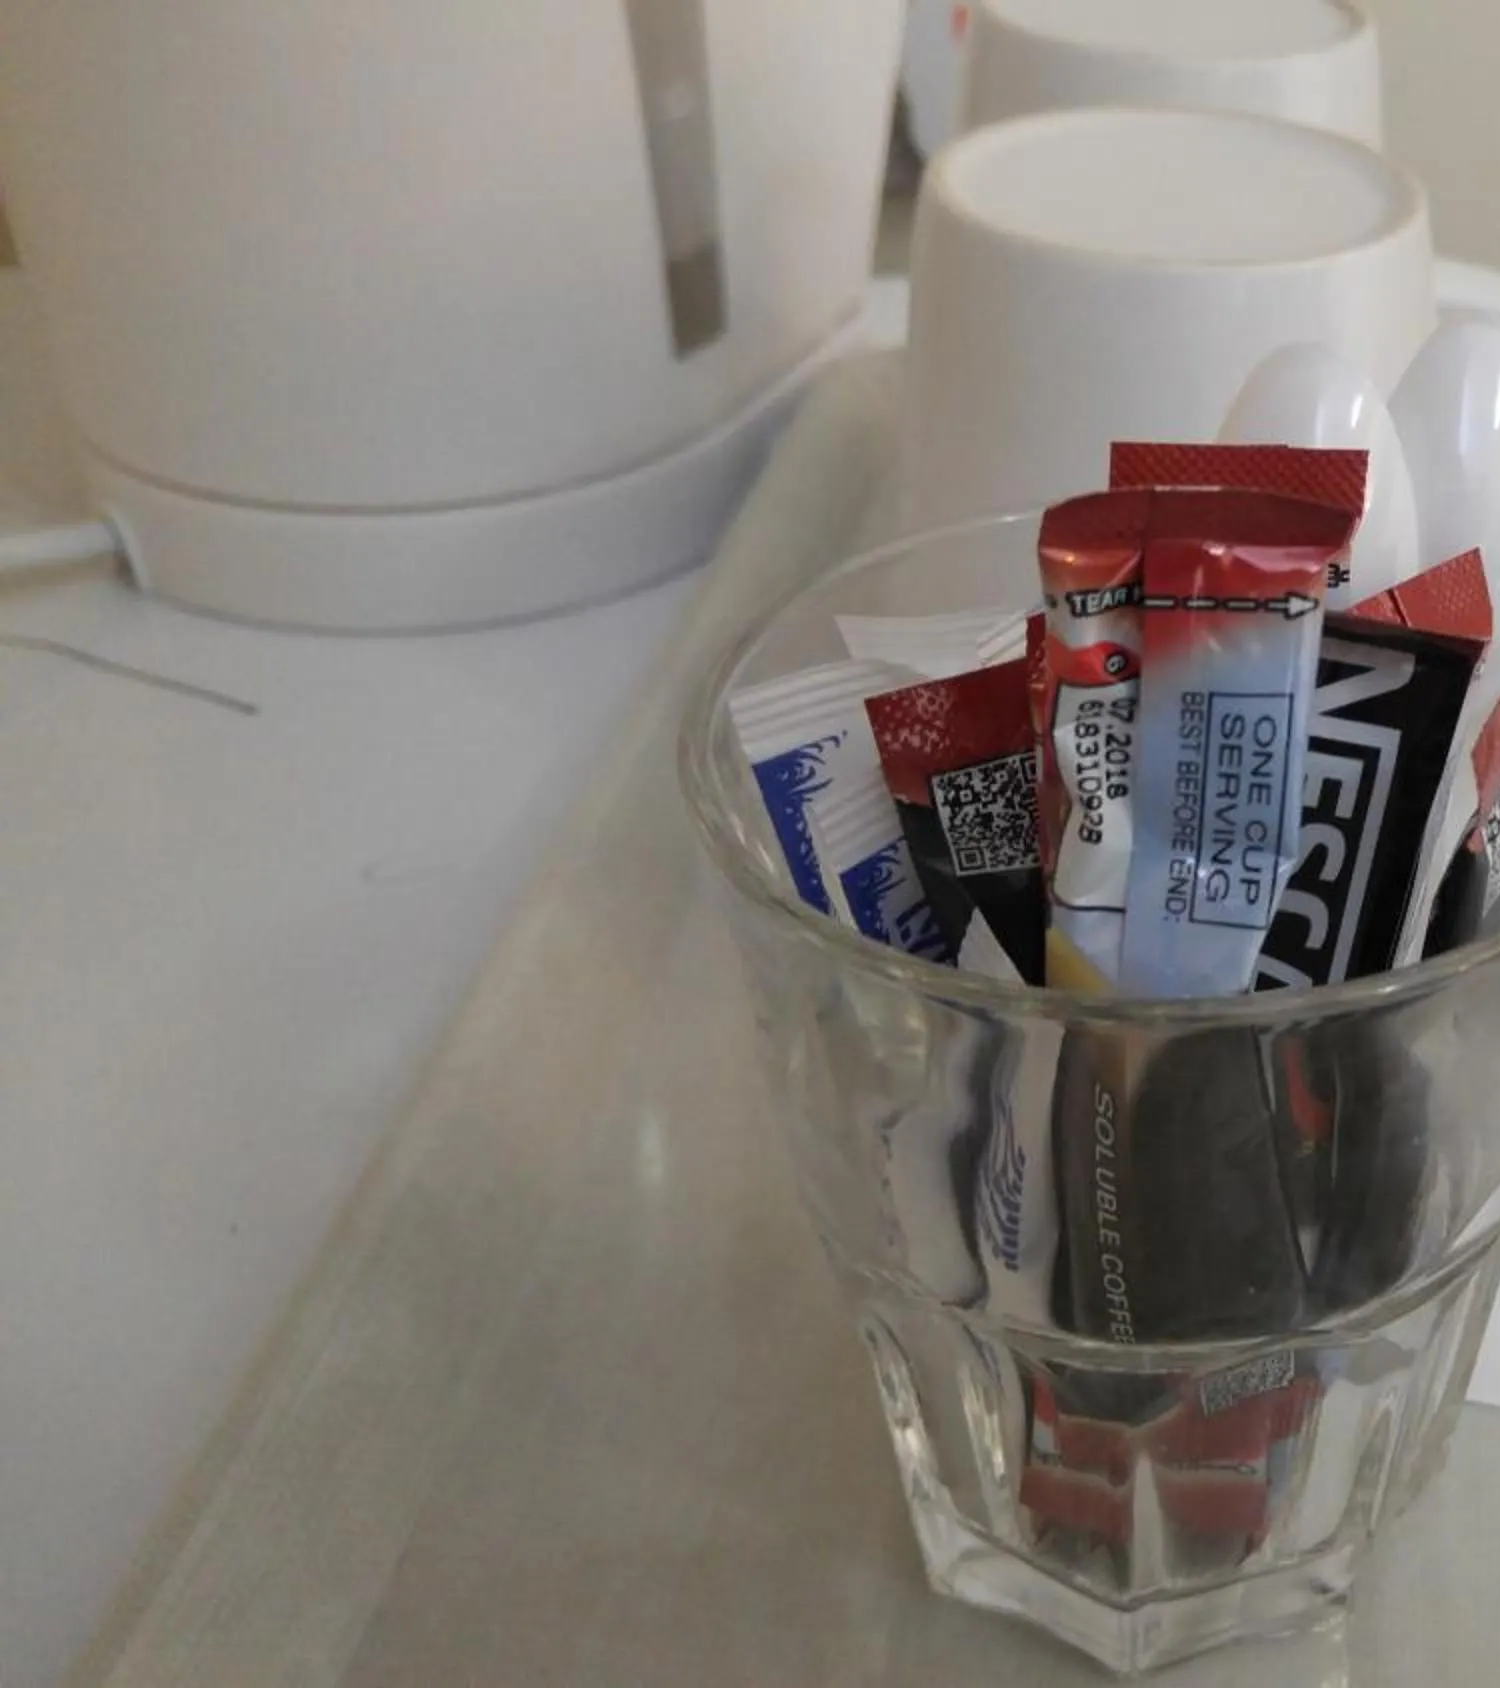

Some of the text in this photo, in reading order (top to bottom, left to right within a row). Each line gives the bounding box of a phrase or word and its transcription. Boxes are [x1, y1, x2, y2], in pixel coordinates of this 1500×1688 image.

[1105, 698, 1137, 800] 07.2018
[1162, 691, 1205, 924] BEST BEFORE END:
[1205, 712, 1246, 904] SERVING
[1239, 714, 1277, 906] ONE CUP
[1094, 1081, 1120, 1248] SOLUBLE
